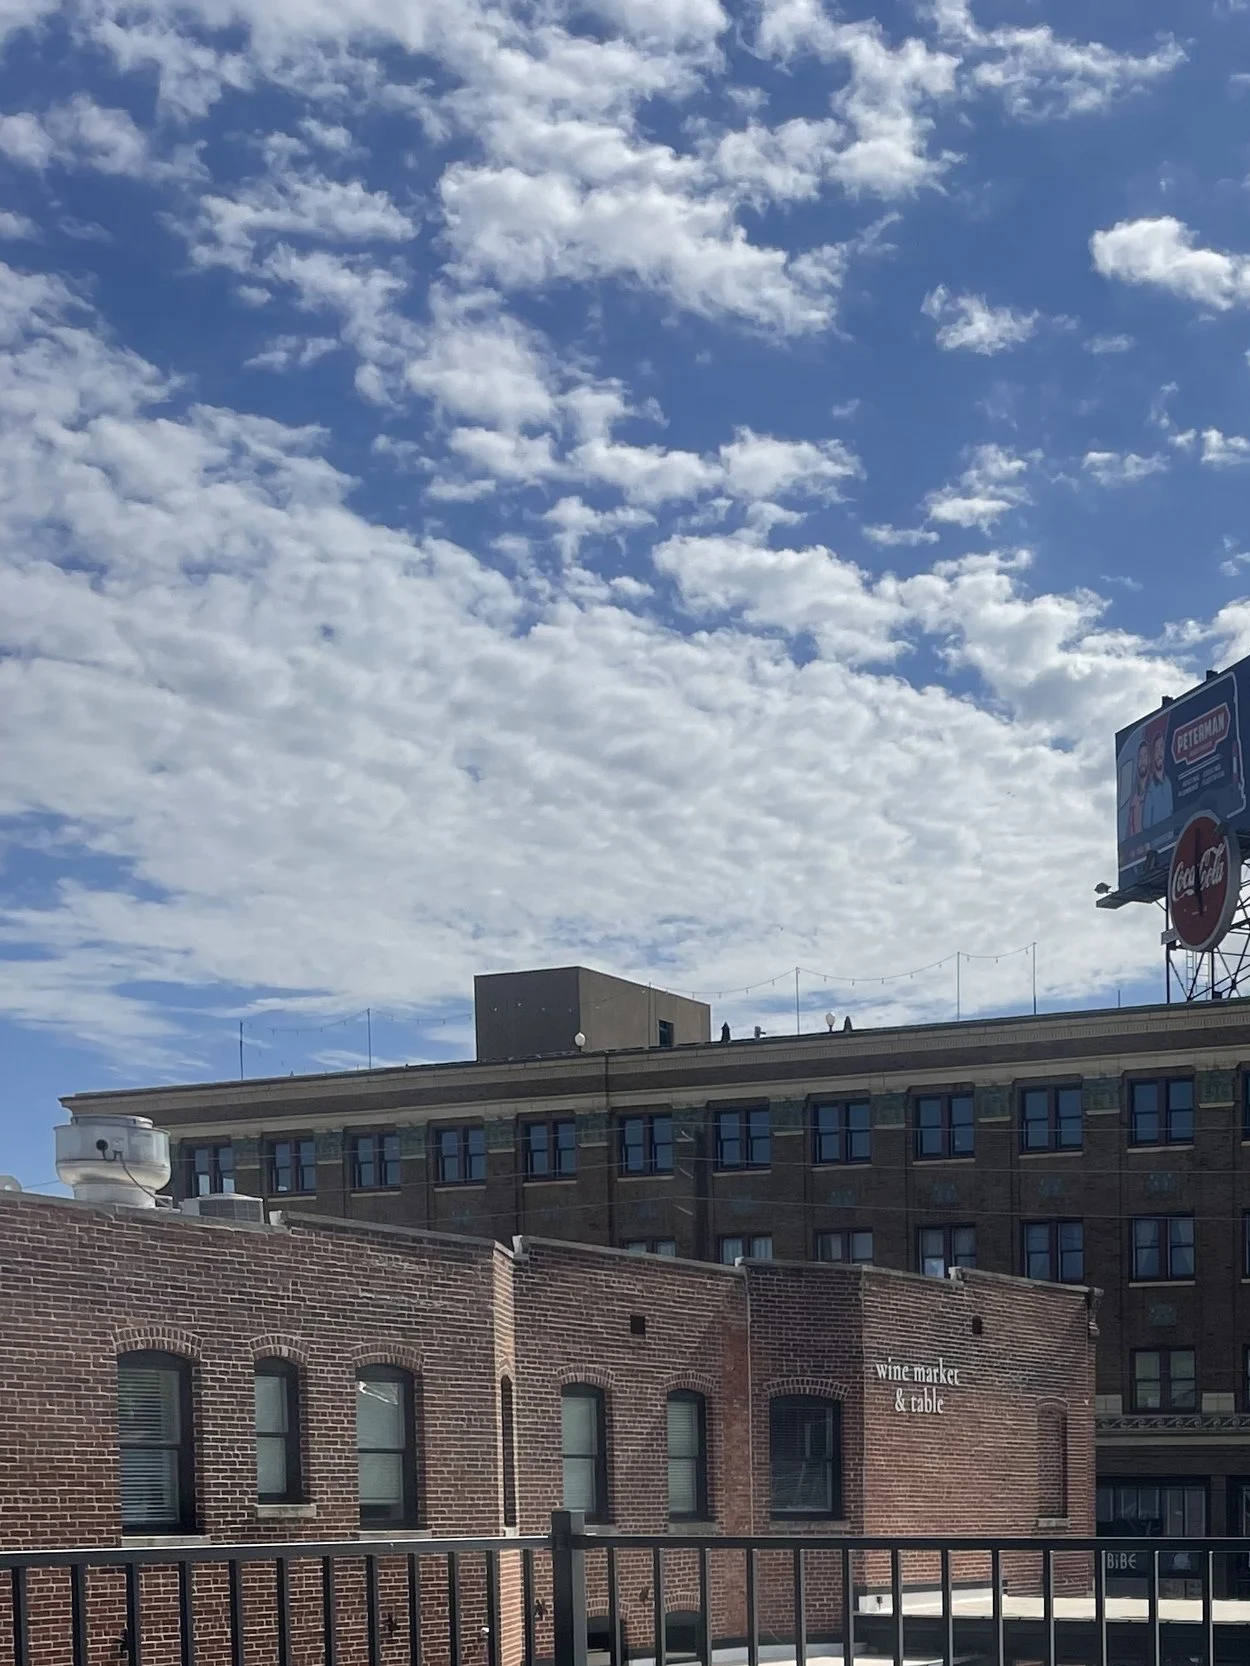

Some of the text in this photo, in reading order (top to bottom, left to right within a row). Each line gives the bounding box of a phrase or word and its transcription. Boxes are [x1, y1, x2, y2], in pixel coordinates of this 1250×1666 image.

[1177, 712, 1224, 753] PETERMAN
[876, 1357, 960, 1386] wine market
[894, 1387, 944, 1414] & table
